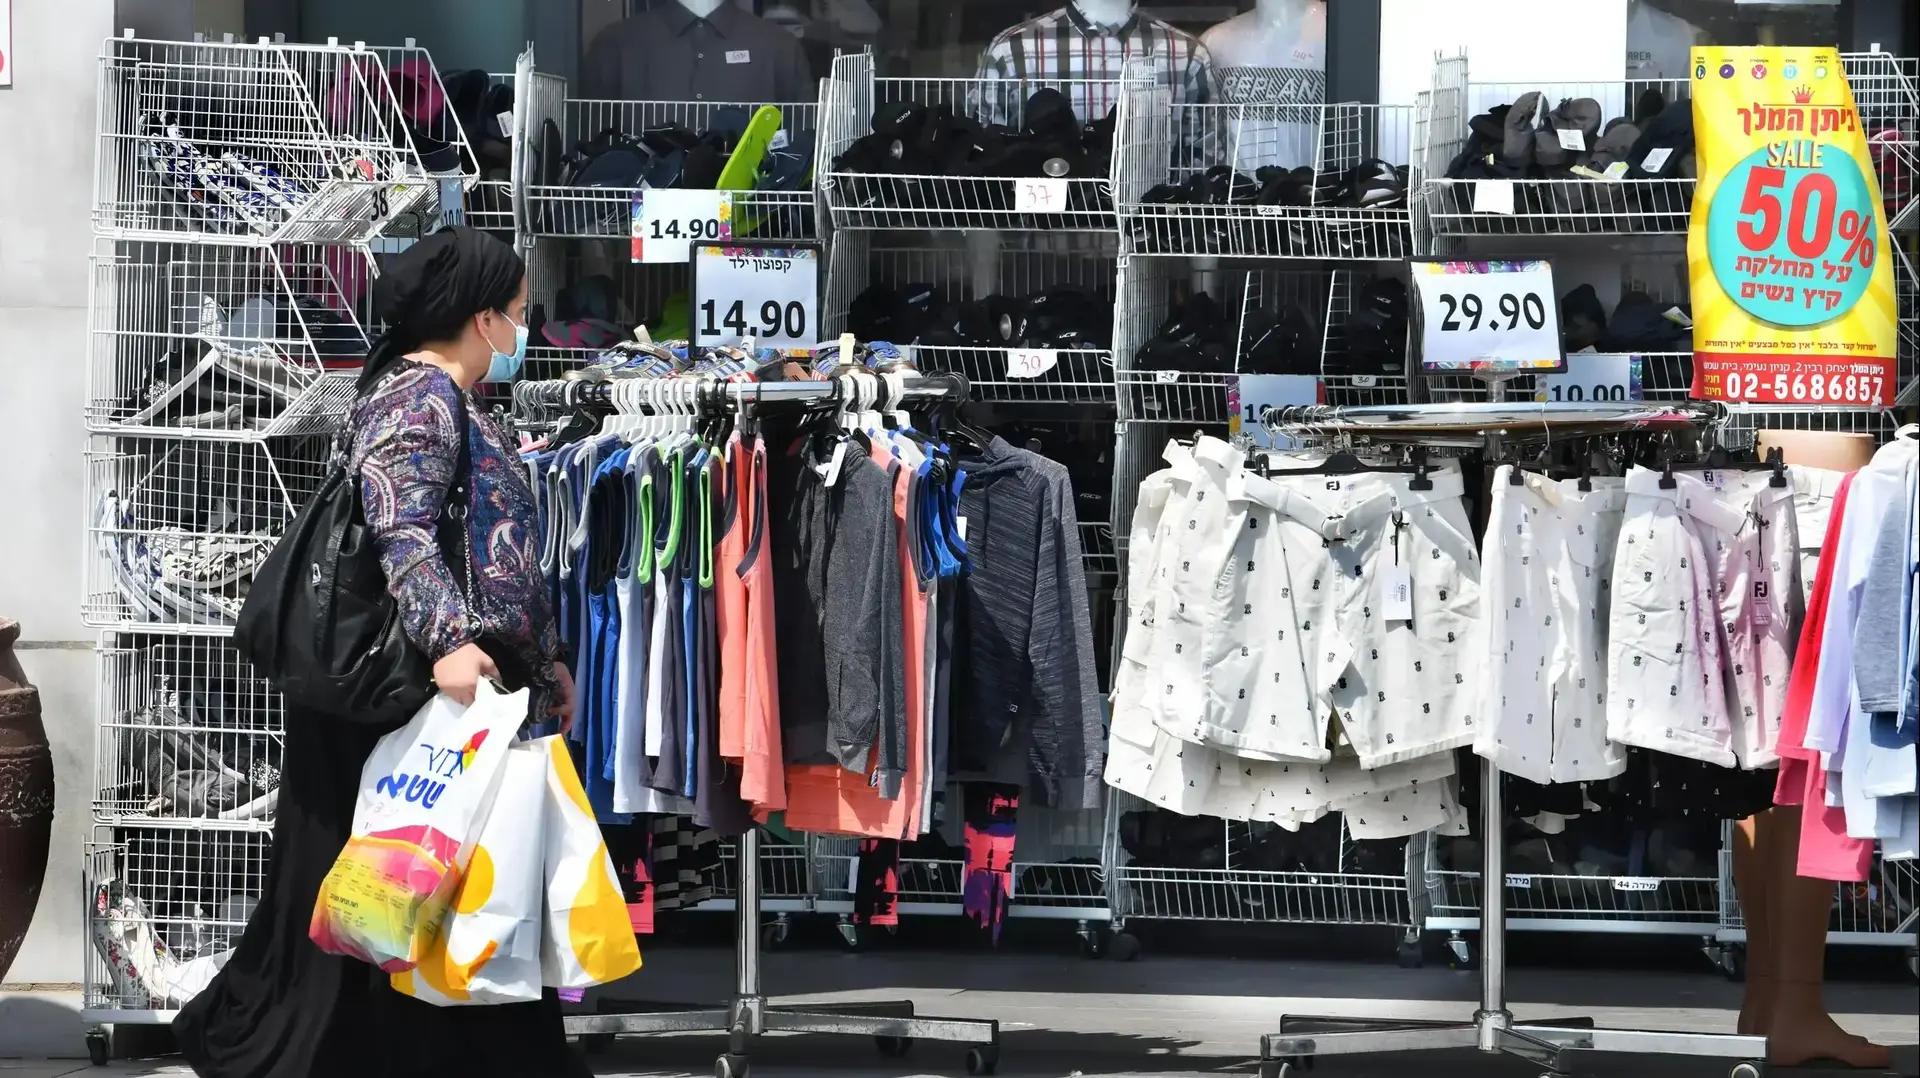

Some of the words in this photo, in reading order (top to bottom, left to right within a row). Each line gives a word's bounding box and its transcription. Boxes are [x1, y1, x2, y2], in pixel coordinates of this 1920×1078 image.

[1737, 102, 1804, 136] המלך
[1766, 140, 1825, 168] SALE
[370, 187, 388, 221] 38
[1025, 184, 1053, 208] 37
[1736, 166, 1875, 269] 50%
[650, 218, 719, 239] 14.90
[729, 255, 749, 269] ילד
[753, 260, 791, 273] קפוצון
[1735, 254, 1814, 278] מחלקת
[1822, 260, 1853, 283] על
[1740, 282, 1794, 302] נשים
[1803, 288, 1842, 311] קיץ
[701, 299, 806, 339] 14.90
[1440, 292, 1546, 331] 29.90
[1748, 341, 1779, 349] מבצעים
[1818, 341, 1839, 349] בלבד
[1720, 362, 1738, 371] בית
[1769, 363, 1791, 374] קניון
[1804, 363, 1823, 374] רבין
[1826, 364, 1849, 374] יצחק
[1551, 384, 1625, 401] 1000
[1726, 372, 1883, 401] 02-5686857
[1703, 471, 1714, 482] FJ
[1754, 581, 1768, 598] FJ
[1617, 880, 1630, 888] 44
[1631, 882, 1657, 890] מידה
